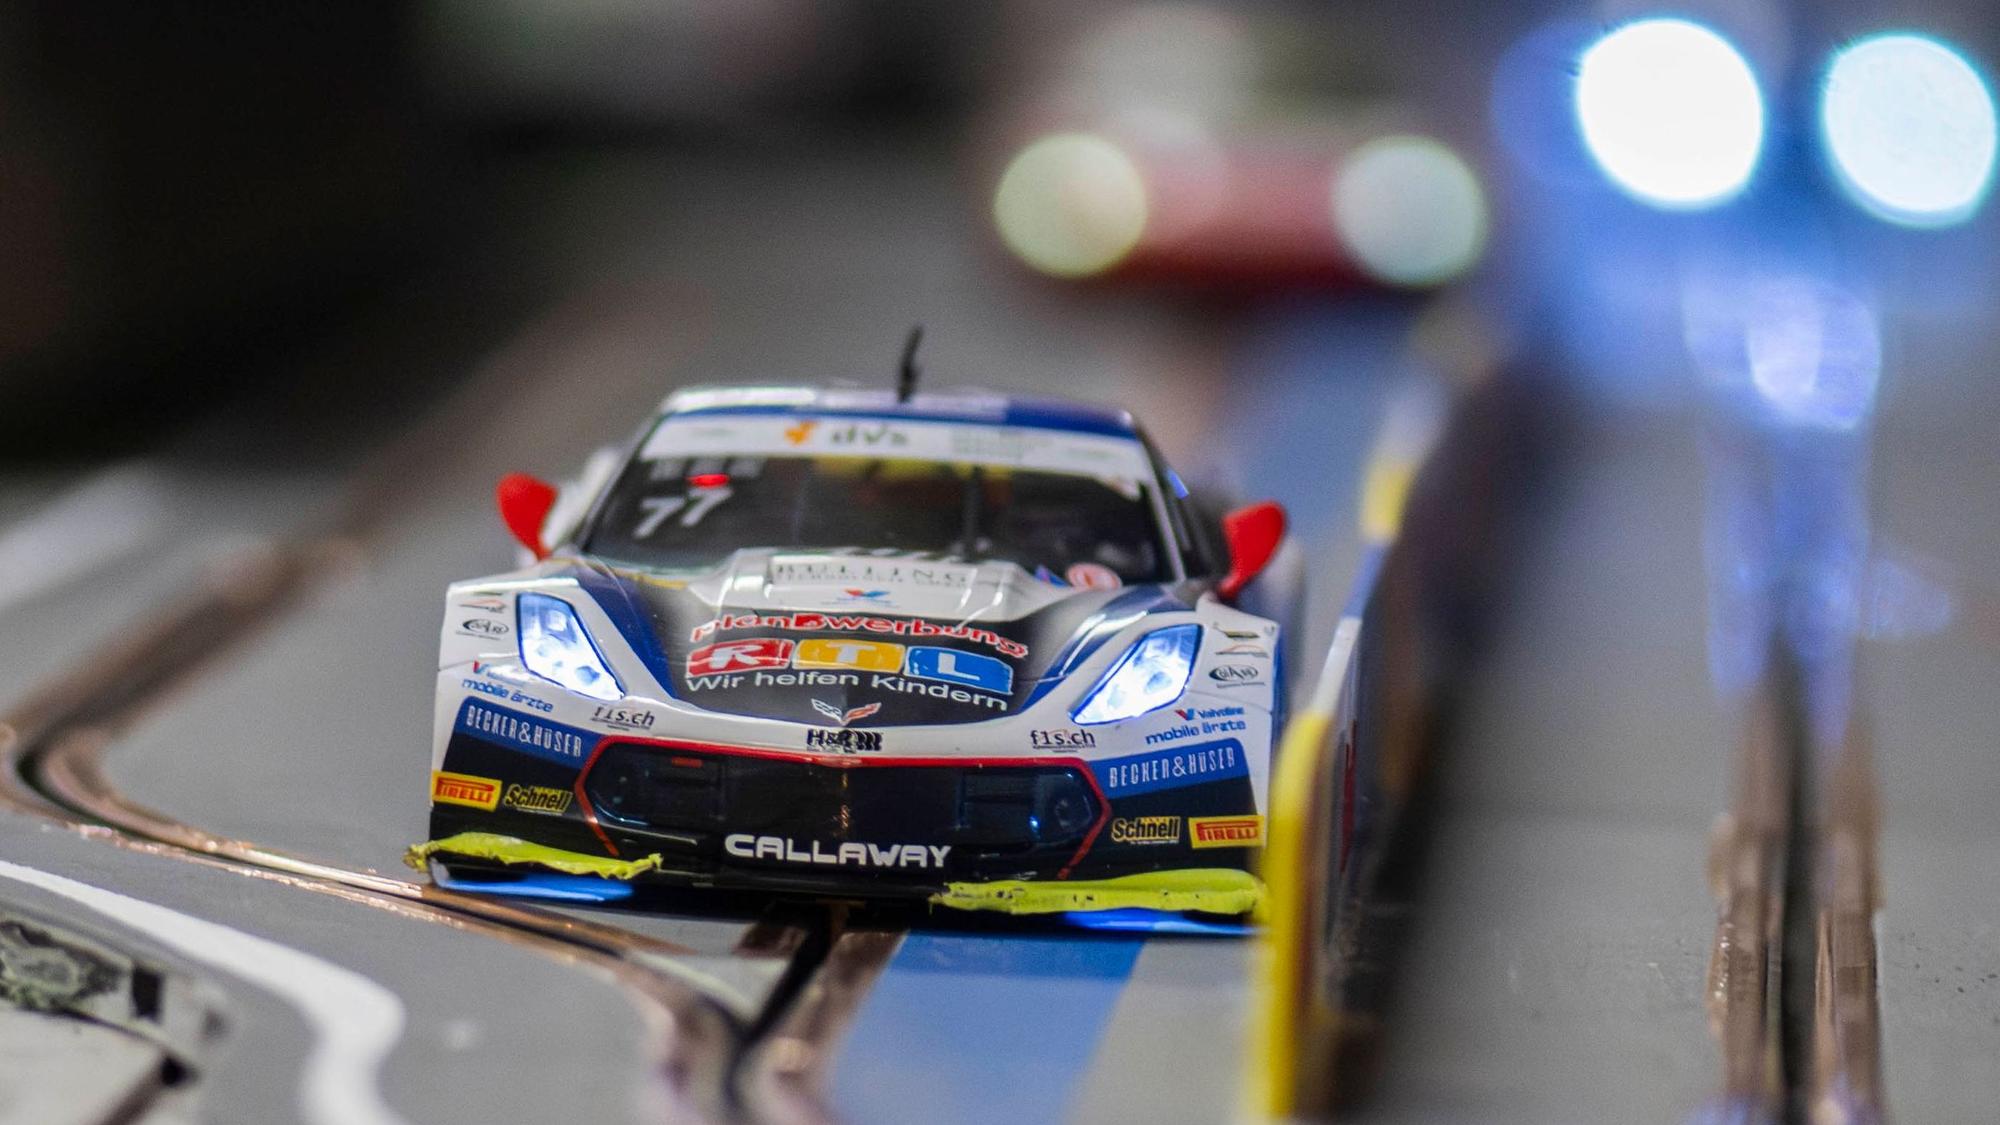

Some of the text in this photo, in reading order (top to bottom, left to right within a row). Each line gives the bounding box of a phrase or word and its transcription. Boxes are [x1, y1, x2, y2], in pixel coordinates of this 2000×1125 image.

[632, 483, 734, 539] 77
[704, 641, 985, 682] RTL
[686, 671, 1008, 712] Wir helfen Kindern
[1030, 728, 1096, 746] f1s.ch
[1145, 724, 1200, 745] mobile
[503, 783, 574, 814] Schnell
[1112, 816, 1181, 842] Schnell
[724, 833, 952, 868] CALLAWAY
